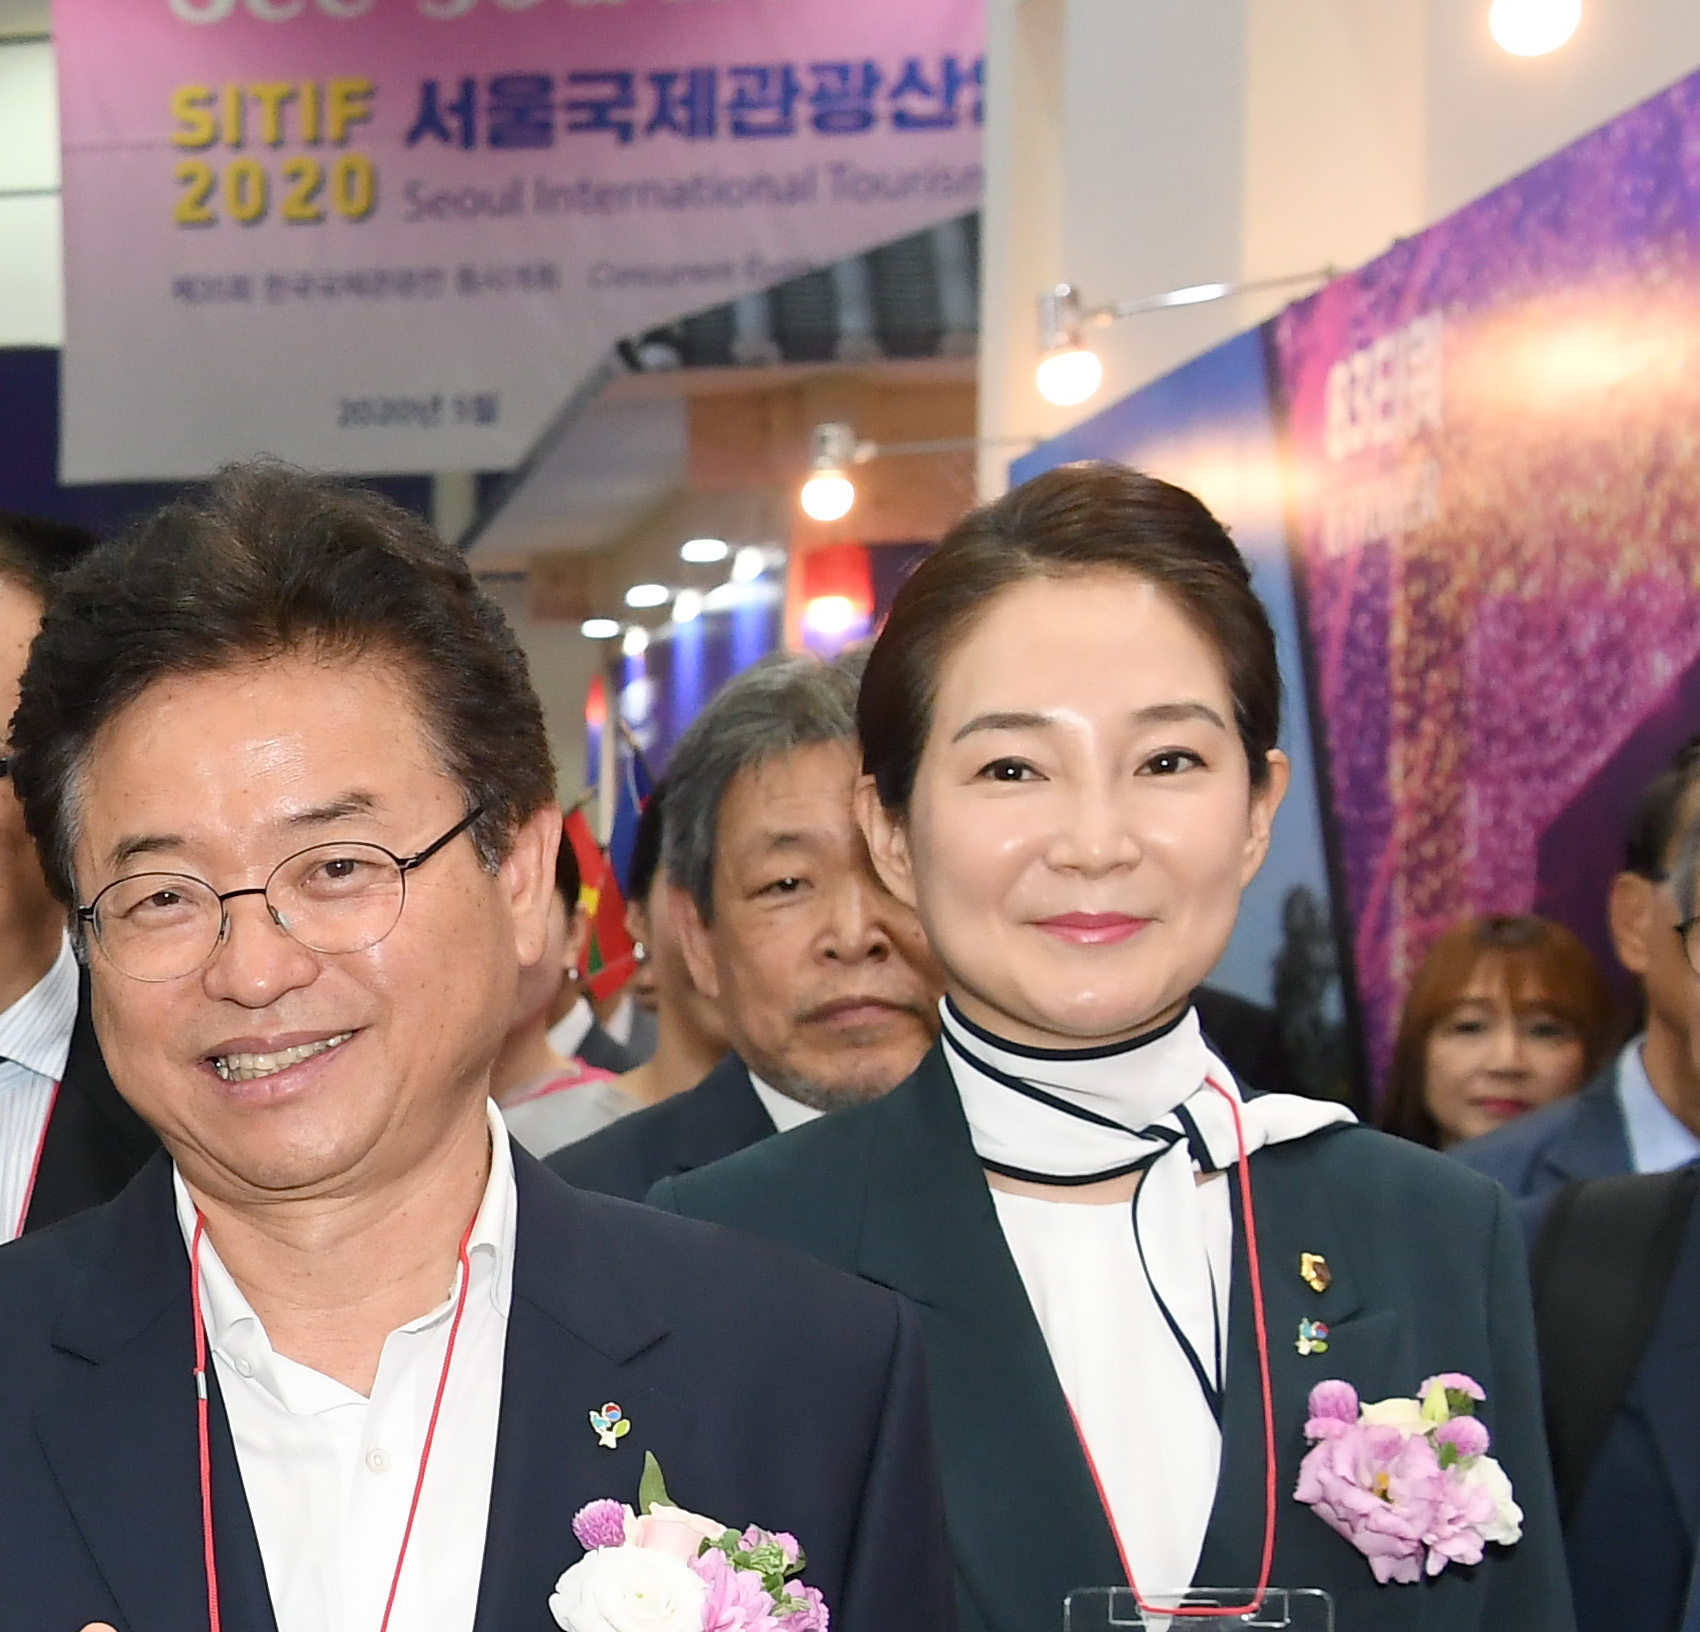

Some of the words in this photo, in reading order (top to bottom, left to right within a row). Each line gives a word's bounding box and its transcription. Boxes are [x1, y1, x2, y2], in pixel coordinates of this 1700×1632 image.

[171, 77, 375, 148] SITIF
[405, 55, 985, 150] 서울국제관광산
[173, 154, 376, 226] 2020
[404, 177, 525, 221] Seoul
[534, 166, 817, 217] International
